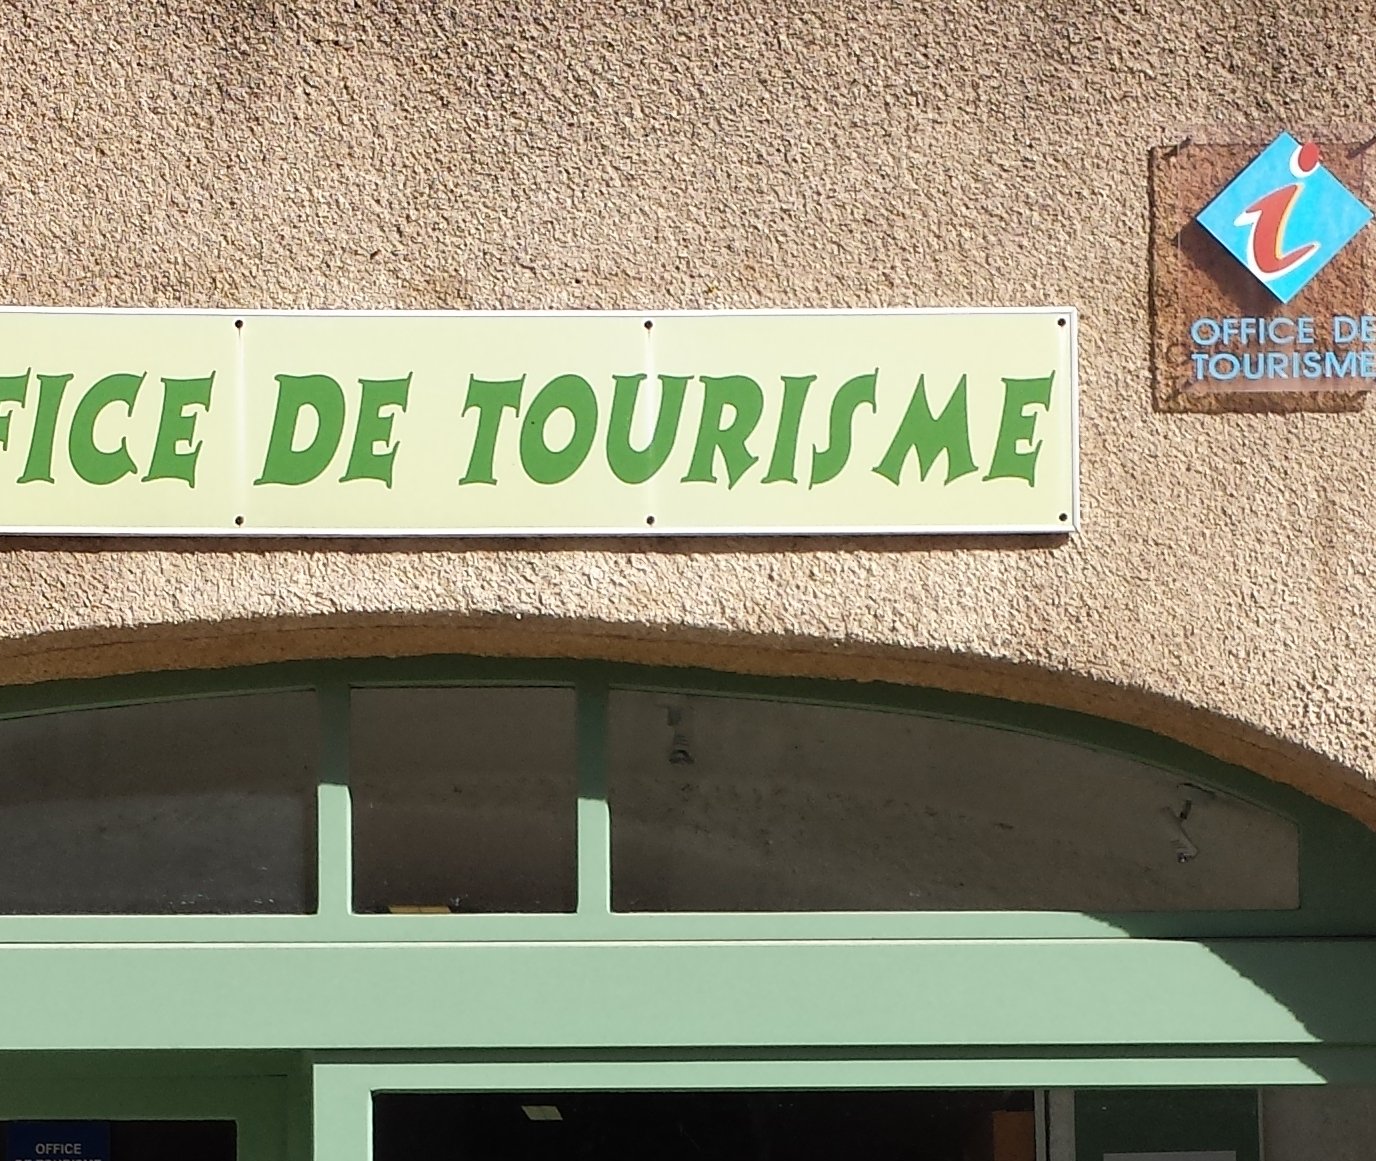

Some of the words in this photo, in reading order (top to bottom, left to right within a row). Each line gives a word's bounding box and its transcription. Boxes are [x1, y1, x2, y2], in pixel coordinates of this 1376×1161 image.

[1190, 316, 1315, 346] OFFICE
[253, 371, 414, 488] DE
[458, 367, 1056, 490] TOURISME
[35, 1142, 82, 1155] OFFICE
